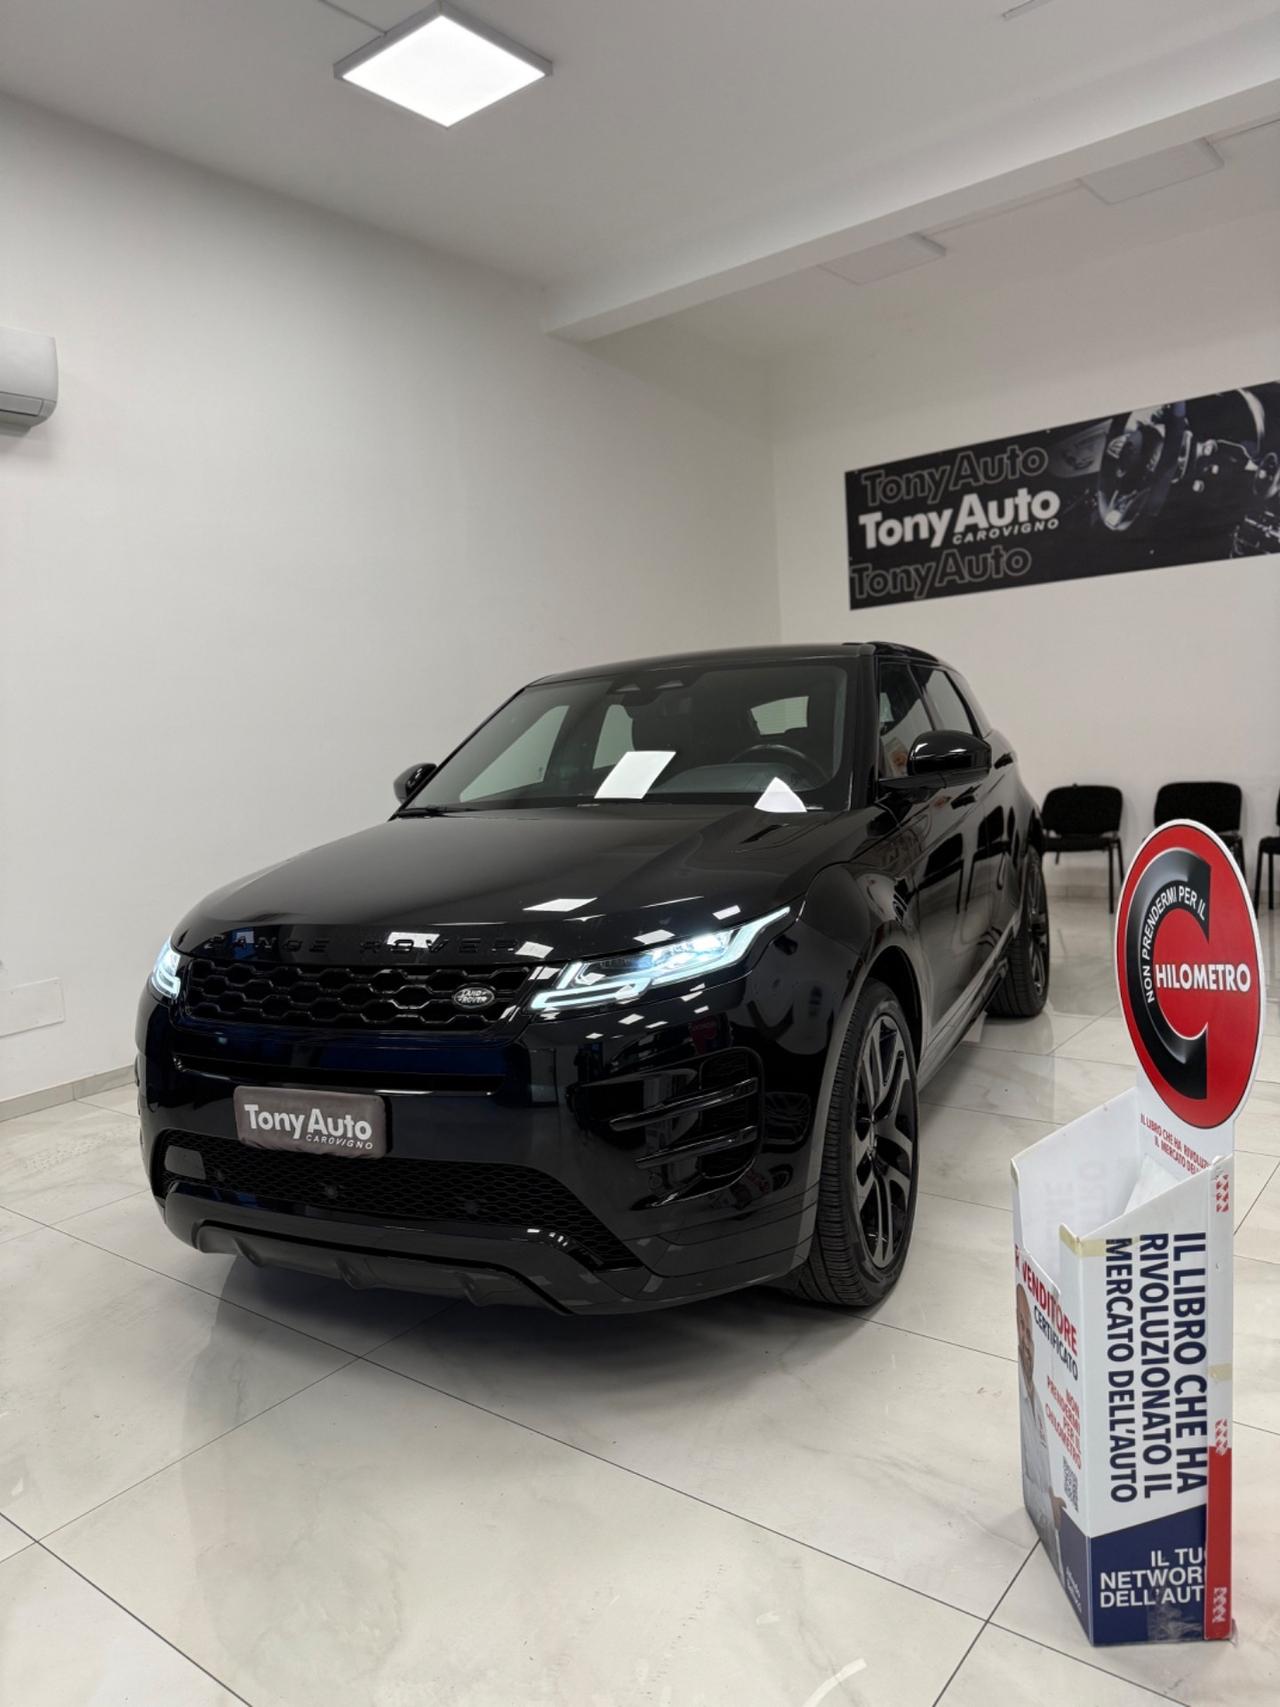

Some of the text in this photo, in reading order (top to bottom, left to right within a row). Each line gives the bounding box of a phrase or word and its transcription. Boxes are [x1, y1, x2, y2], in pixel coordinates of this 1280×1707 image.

[861, 445, 1049, 506] Tony Auto
[859, 488, 1060, 549] Tony Auto
[952, 518, 1060, 545] CAROVIGNO
[851, 545, 1032, 600] Tony Auto
[1142, 885, 1206, 1003] NON PRENDERMI PER IL
[1155, 963, 1252, 992] HILOMETRO
[244, 1104, 372, 1140] Tony Auto
[305, 1134, 373, 1150] CAROVIGNO
[1184, 1144, 1211, 1170] RIVOLUZ
[1022, 1261, 1078, 1357] VENDITORE
[1034, 1305, 1079, 1381] CERTIFICATO
[1106, 1238, 1138, 1503] MERCATO DELL'AUTO
[1139, 1233, 1172, 1499] RIVOLUZIONATO IL
[1173, 1232, 1207, 1494] IL LIBRO CHE HA
[1100, 1566, 1204, 1590] NETWOR
[1151, 1547, 1204, 1567] IL TU
[1100, 1585, 1205, 1608] DELL'AUT
